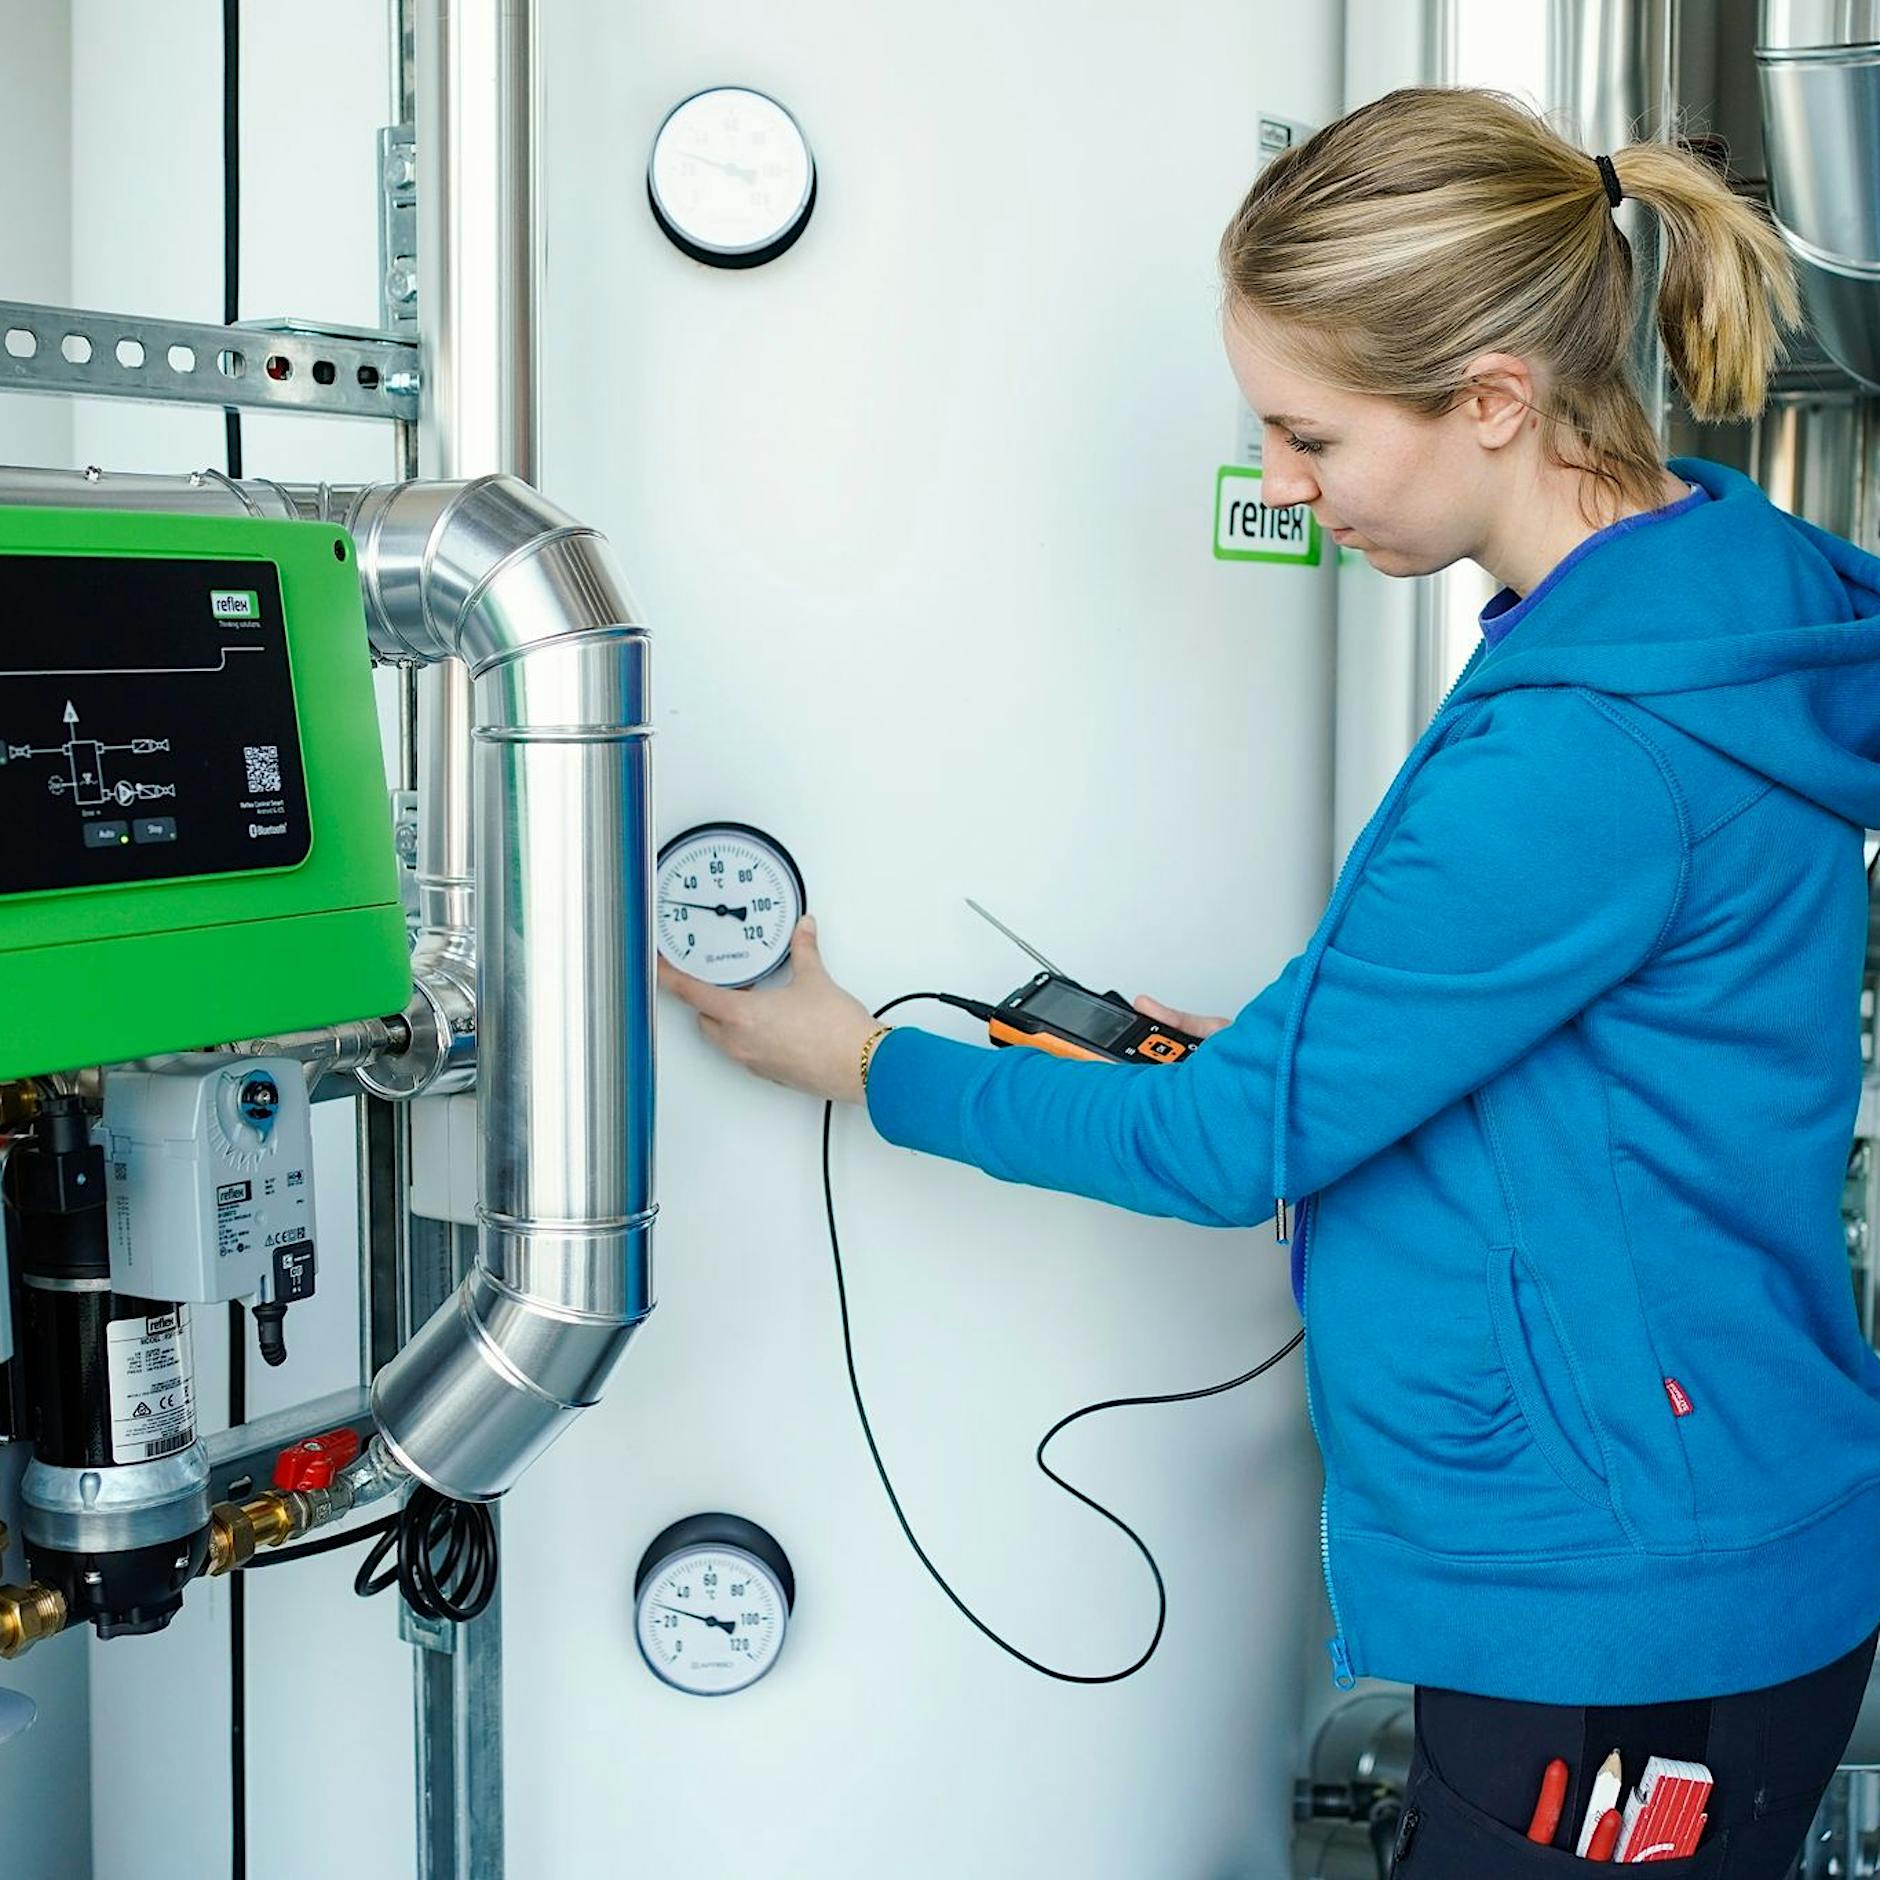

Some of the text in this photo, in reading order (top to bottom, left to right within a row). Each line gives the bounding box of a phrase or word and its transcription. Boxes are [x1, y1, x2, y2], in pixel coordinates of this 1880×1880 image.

[216, 596, 248, 611] reflex
[709, 861, 724, 875] 60
[683, 876, 698, 889] 40
[738, 868, 753, 883] 80
[751, 898, 772, 912] 100
[673, 907, 688, 922] 20
[743, 925, 764, 940] 120
[687, 933, 695, 947] 0
[149, 1317, 174, 1331] reflex
[703, 1574, 717, 1587] 60
[676, 1586, 690, 1599] 40
[730, 1584, 745, 1597] 80
[664, 1614, 678, 1628] 20
[740, 1612, 760, 1626] 100
[675, 1639, 683, 1652] 0
[730, 1638, 750, 1651] 120
